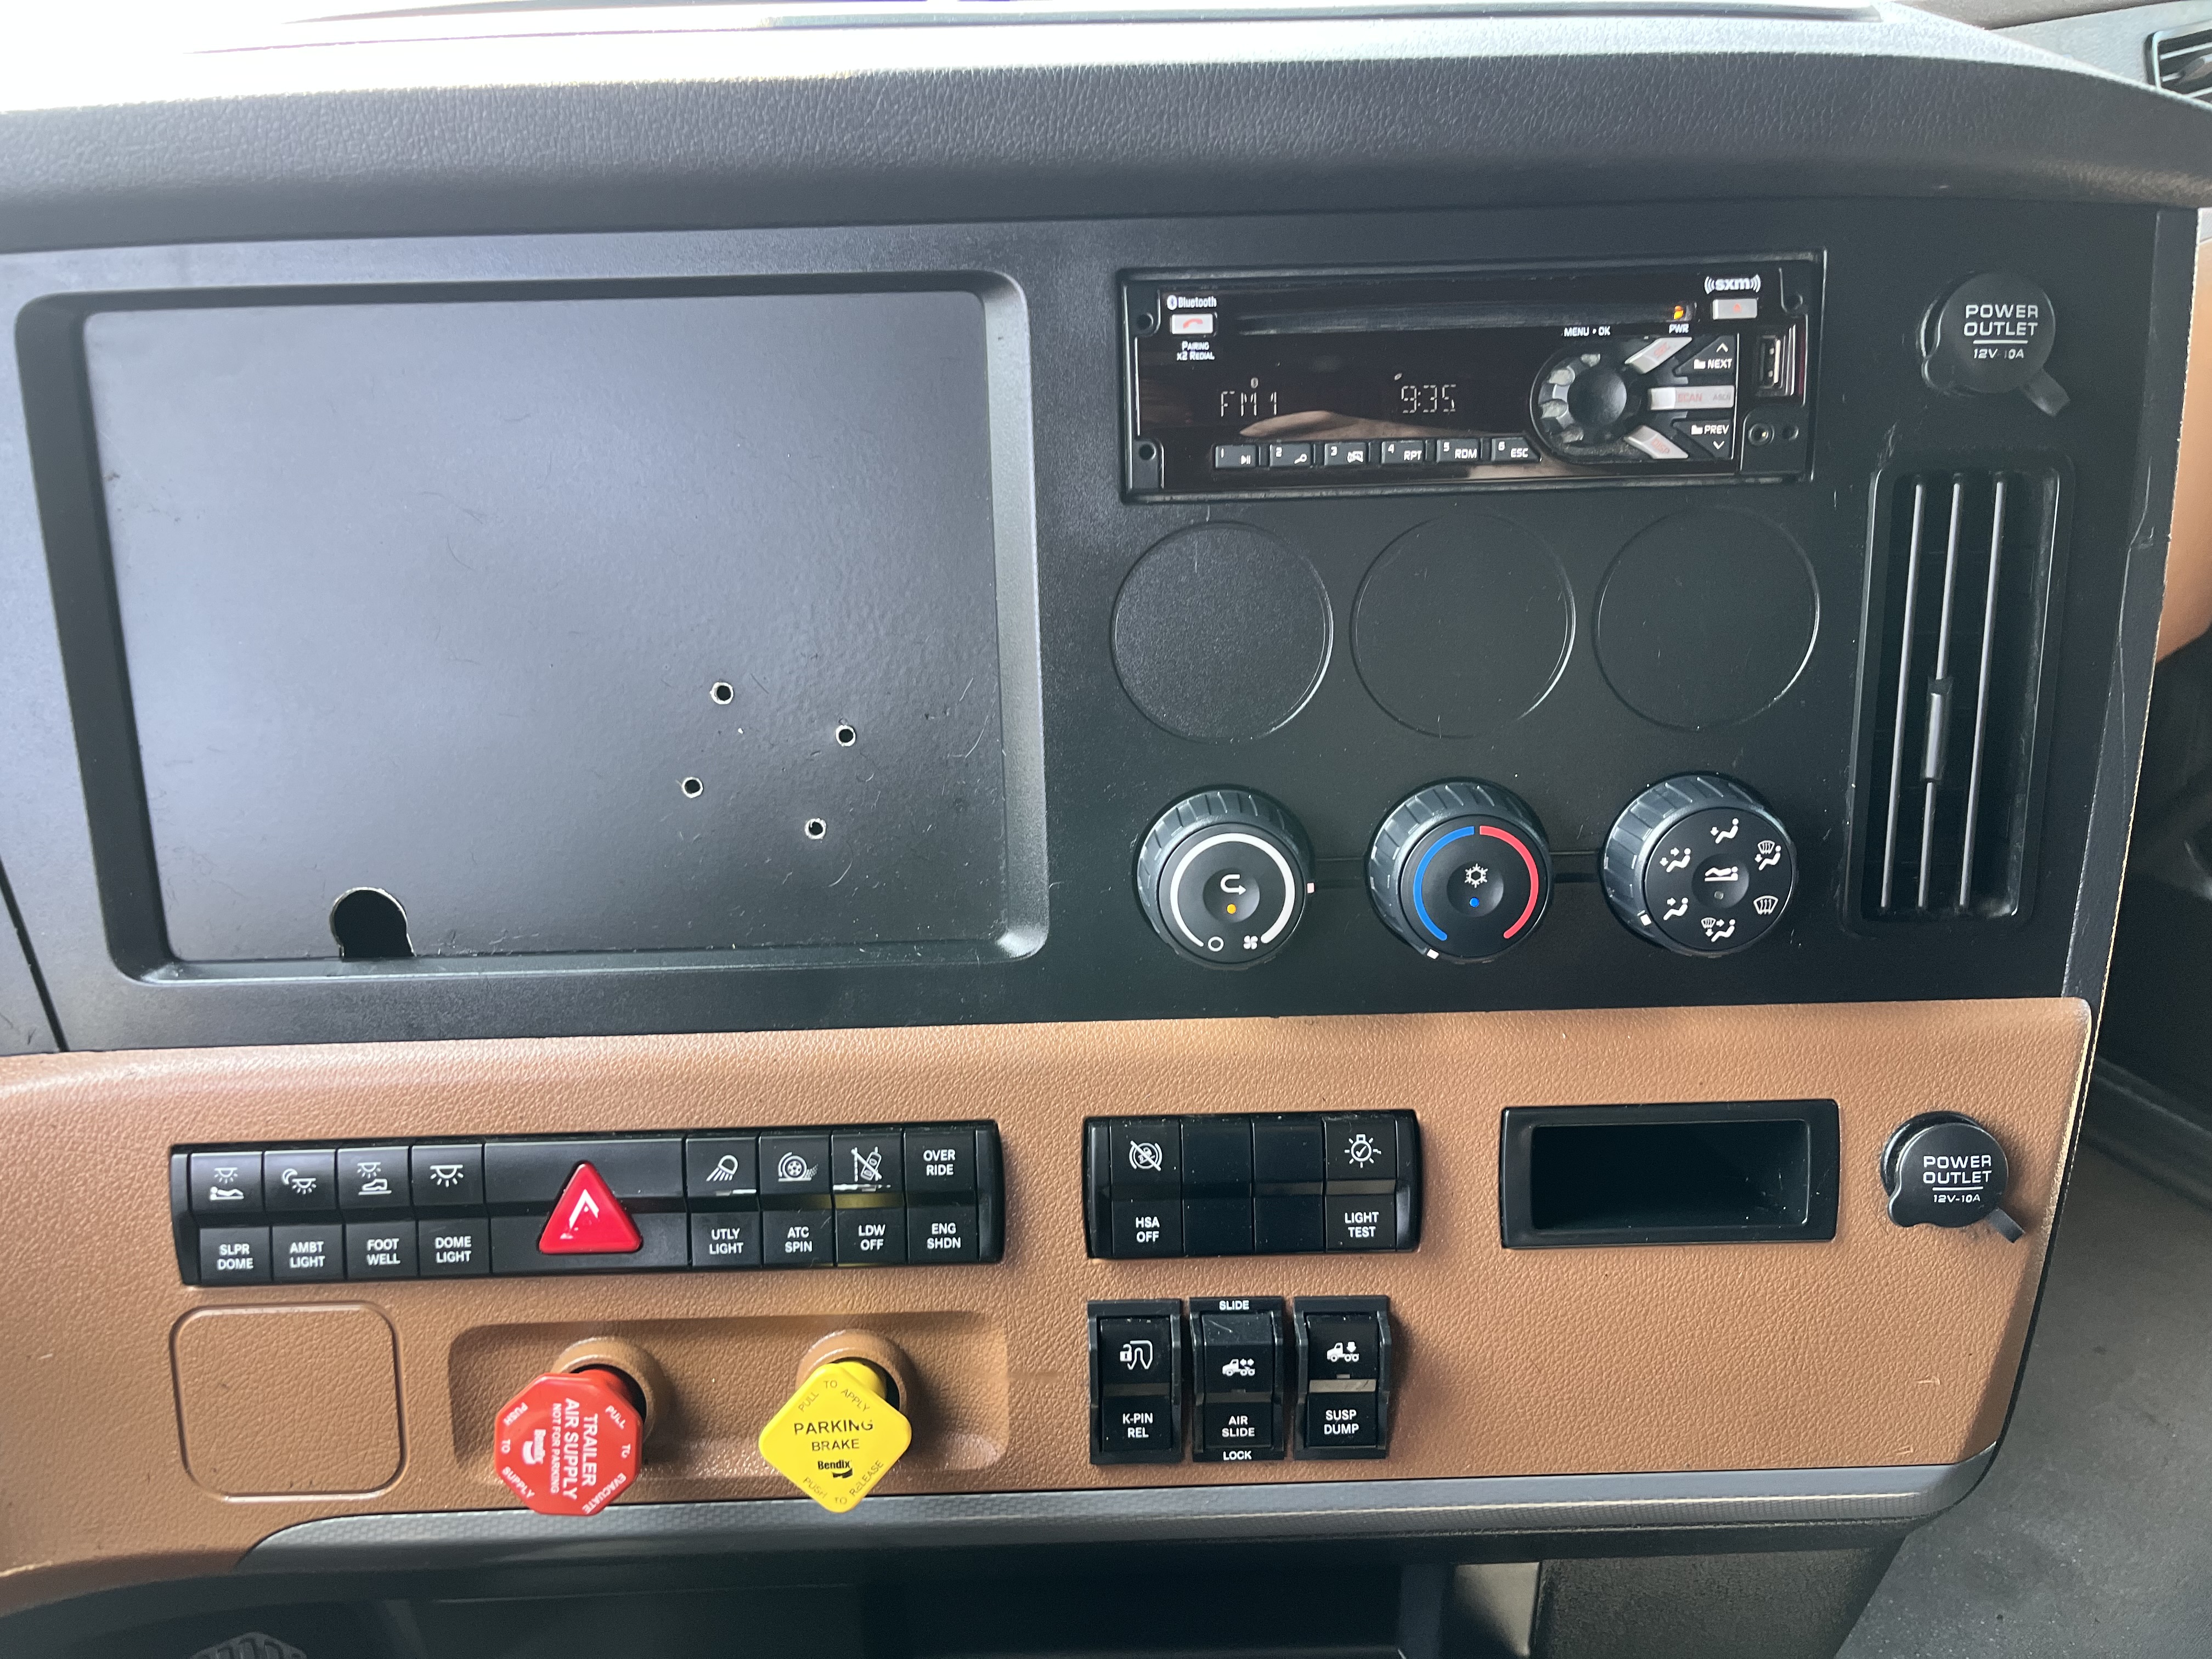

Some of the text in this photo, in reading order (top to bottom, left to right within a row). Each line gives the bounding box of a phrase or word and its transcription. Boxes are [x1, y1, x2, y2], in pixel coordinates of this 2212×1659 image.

[1178, 296, 1217, 308] Bluetooth
[1965, 304, 2039, 319] POWER
[1564, 326, 1611, 337] MENU OK
[1669, 323, 1689, 334] PWR
[1963, 321, 2038, 336] OUTLET
[1182, 340, 1210, 351] PAIRING
[1189, 351, 1215, 360] REDIAL
[1707, 358, 1733, 369] NEXT
[1401, 384, 1456, 413] 9:35
[1677, 393, 1703, 403] SCAN
[1703, 424, 1730, 435] PREV
[1330, 445, 1338, 456] 3
[1387, 443, 1395, 454] 4
[1443, 441, 1450, 452] 5
[1498, 441, 1505, 451] 6
[1220, 447, 1224, 459] 1
[1276, 447, 1283, 458] 2
[1403, 450, 1423, 461] RPT
[1454, 448, 1477, 459] RDM
[1510, 448, 1529, 458] ESC
[923, 1149, 956, 1163] OVER
[1923, 1154, 1991, 1169] POWER
[926, 1164, 954, 1176] RIDE
[1923, 1170, 1992, 1184] OUTLET
[1933, 1194, 1980, 1203] 12V-10A
[1136, 1217, 1160, 1229] HSA
[1345, 1212, 1379, 1224] LIGHT
[712, 1228, 740, 1240] UTLY
[787, 1227, 809, 1239] ATC
[859, 1224, 885, 1237] LDW
[932, 1223, 956, 1235] ENG
[1348, 1226, 1376, 1238] TEST
[435, 1236, 471, 1249] DOME
[1136, 1231, 1159, 1243] OFF
[290, 1242, 324, 1254] AMBT
[367, 1238, 399, 1251] FOOT
[709, 1243, 743, 1255] LIGHT
[785, 1241, 812, 1253] SPIN
[860, 1239, 883, 1251] OFF
[927, 1237, 961, 1250] SHDN
[220, 1244, 250, 1256] SLPR
[290, 1256, 325, 1268] LIGHT
[367, 1252, 400, 1265] WELL
[436, 1250, 471, 1263] LIGHT
[217, 1258, 253, 1271] DOME
[1218, 1300, 1250, 1311] SLIDE
[798, 1380, 870, 1412] PULL TO APPLY
[1122, 1412, 1153, 1425] K-PIN
[1228, 1415, 1248, 1425] AIR
[1325, 1409, 1357, 1421] SUSP
[794, 1419, 874, 1436] PARKING
[1127, 1427, 1149, 1438] REL
[1222, 1427, 1255, 1438] SLIDE
[1324, 1423, 1359, 1435] DUMP
[501, 1402, 535, 1499] PUSH TO SUPPLY
[550, 1403, 562, 1494] NOT FOR PARKING
[563, 1398, 579, 1499] AIR SUPPLY
[582, 1413, 598, 1486] TRAILER
[811, 1438, 860, 1452] BRAKE
[582, 1405, 631, 1514] PULL TO EVACUATE
[1223, 1450, 1252, 1461] LOCK
[817, 1459, 850, 1470] Bendix
